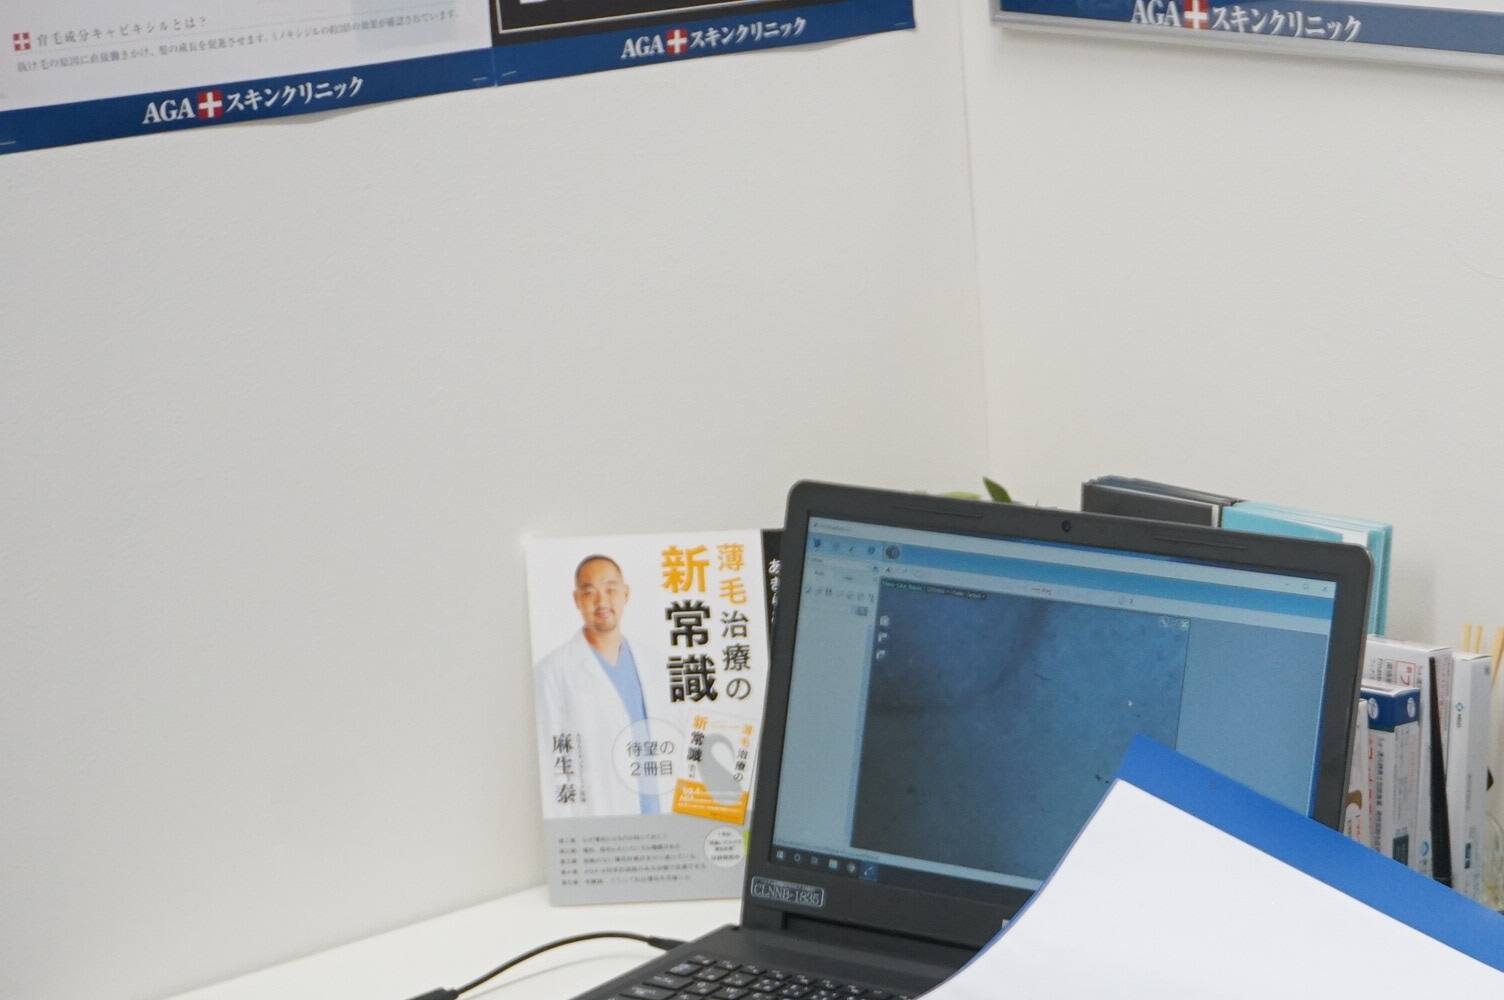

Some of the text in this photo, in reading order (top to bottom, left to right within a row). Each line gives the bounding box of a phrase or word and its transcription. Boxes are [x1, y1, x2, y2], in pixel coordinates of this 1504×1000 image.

[621, 16, 807, 60] AGA スキンクリニック
[1131, 0, 1362, 42] AGA スキンクリニック
[141, 75, 364, 125] AGA スキンクリニック
[660, 544, 719, 703] 新常識
[716, 543, 752, 701] 薄毛治療の
[552, 732, 577, 805] 麻生泰
[626, 740, 675, 757] 待望の
